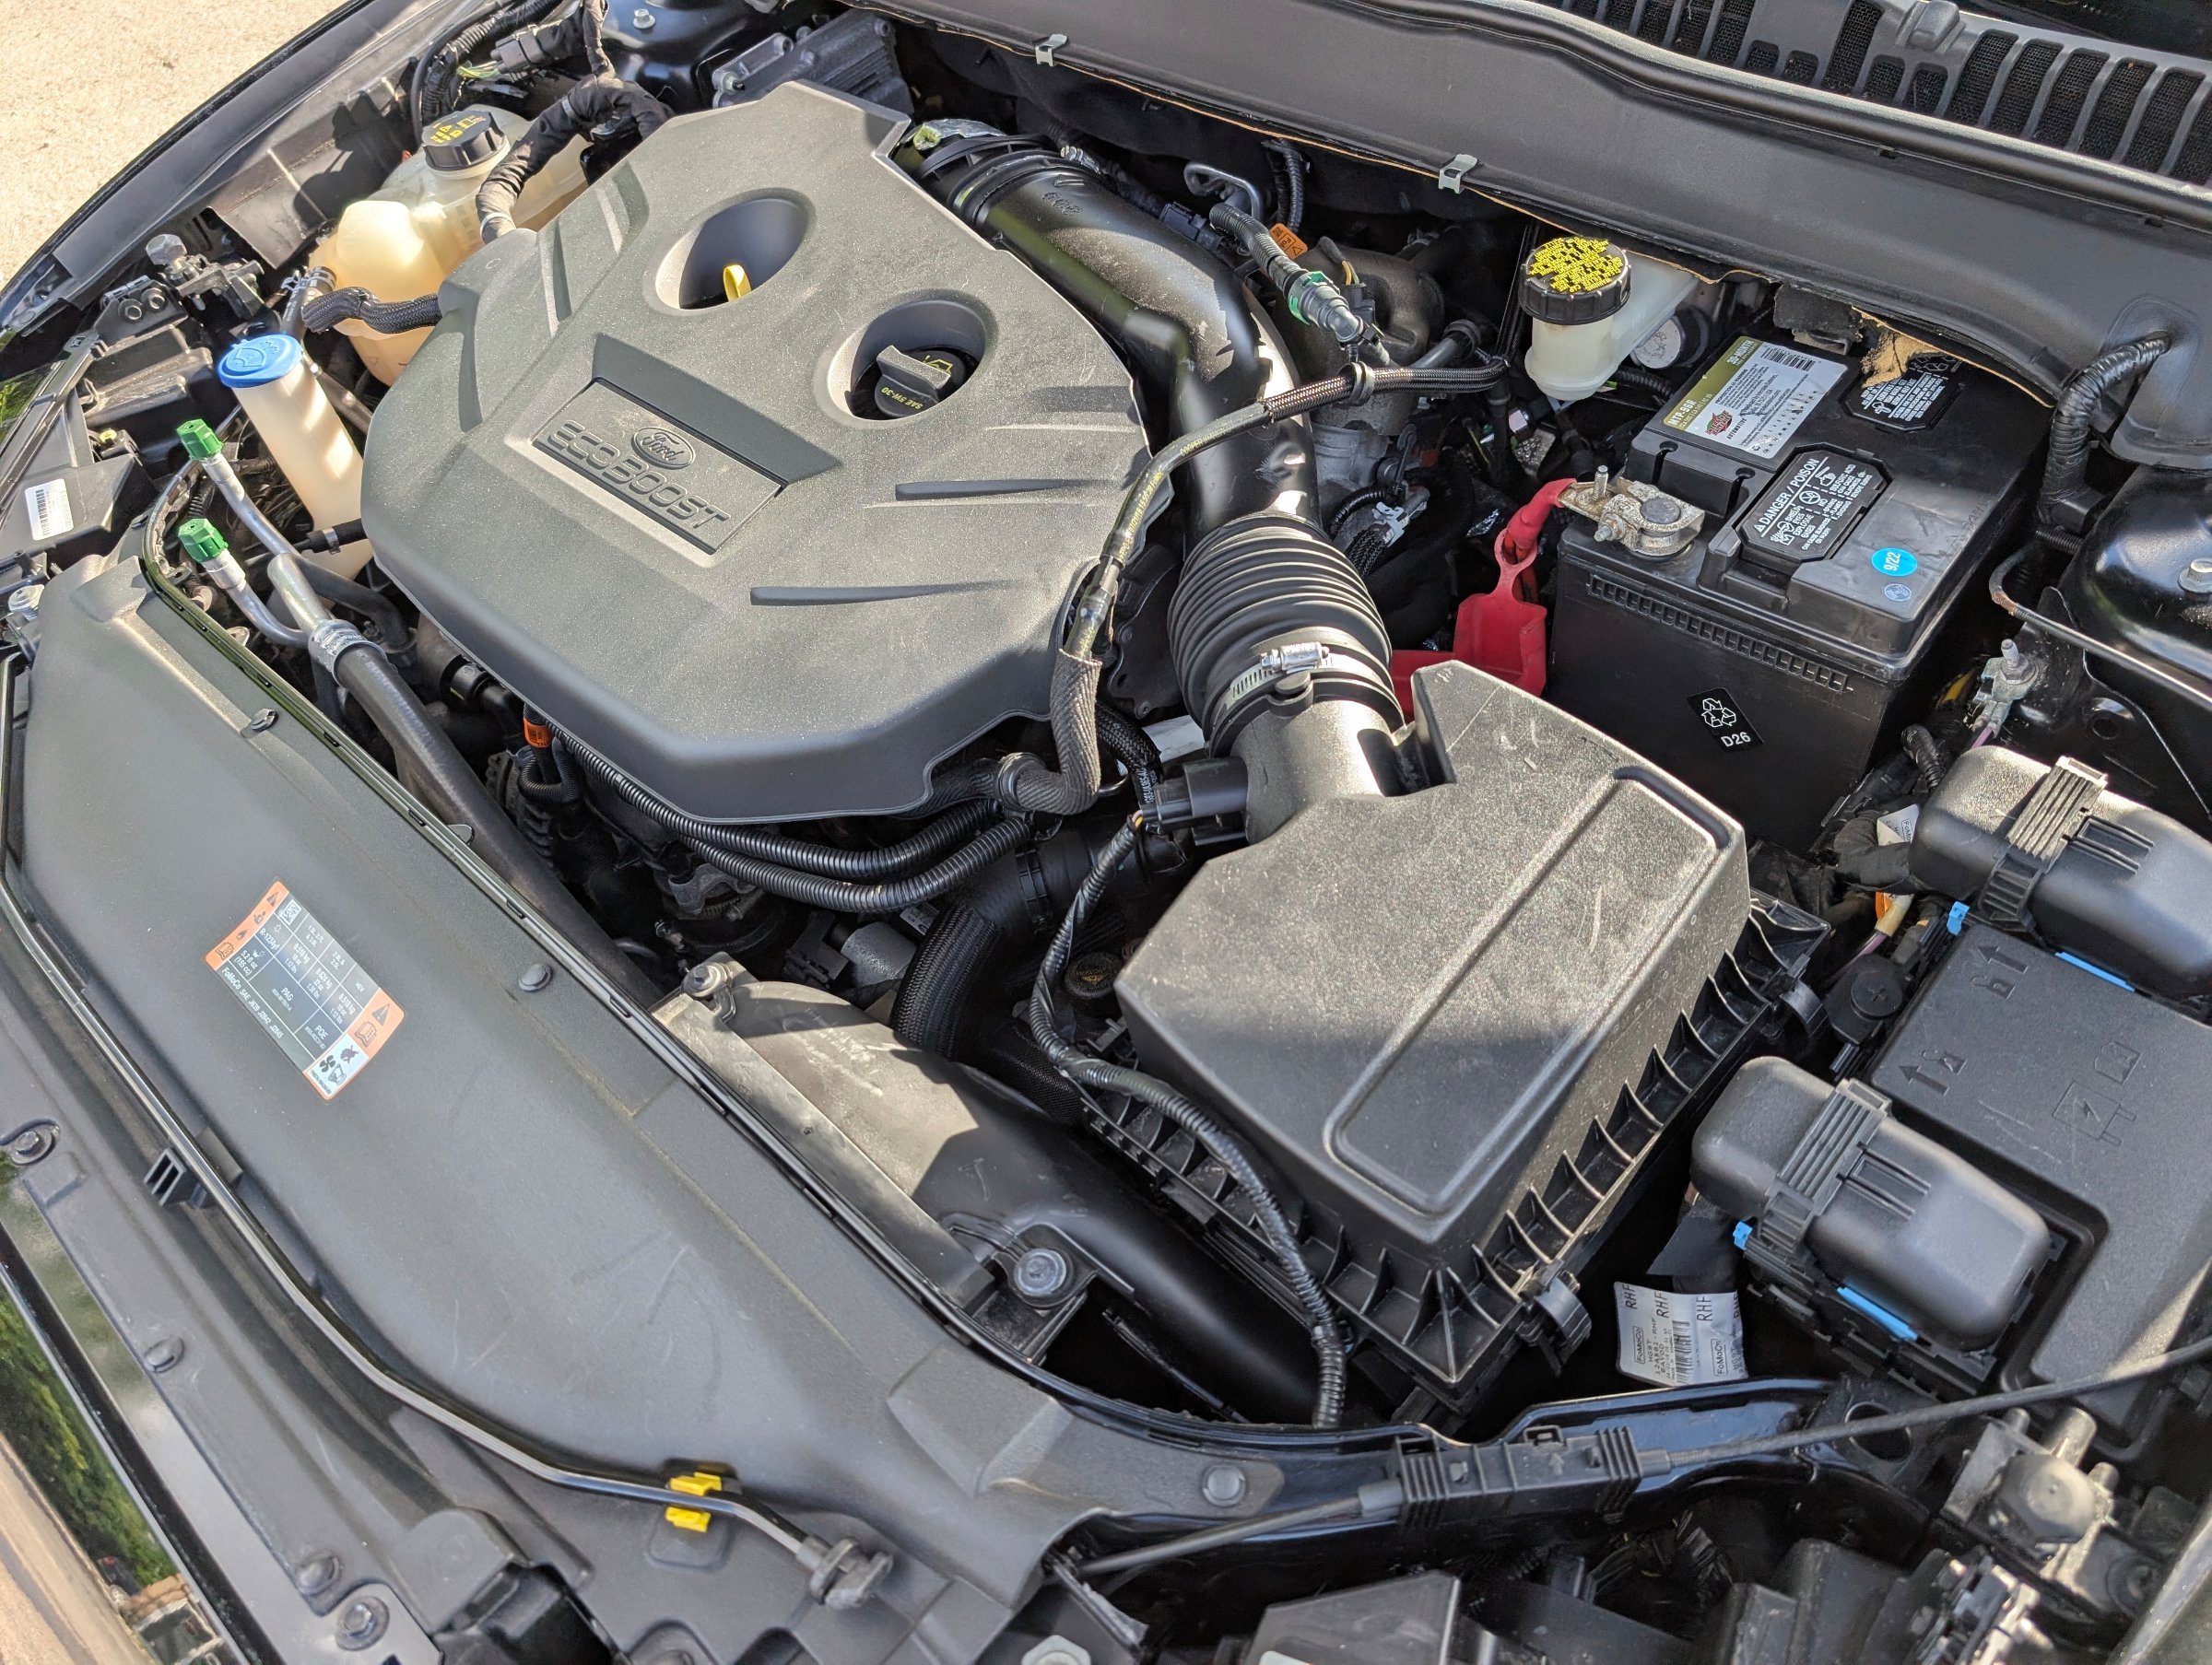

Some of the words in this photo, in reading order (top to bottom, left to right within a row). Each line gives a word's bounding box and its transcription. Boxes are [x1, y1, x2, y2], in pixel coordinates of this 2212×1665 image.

[881, 387, 907, 403] 5W-30
[905, 399, 923, 410] SAE
[1668, 400, 1698, 426] MTP-96R
[642, 431, 685, 463] Ford
[547, 419, 731, 528] ECOBOOST
[1759, 491, 1793, 525] DANGER
[1790, 458, 1820, 488] POISON
[1882, 550, 1903, 573] 9/22
[1720, 732, 1751, 746] D26
[259, 928, 280, 952] R-1234yf
[234, 955, 246, 968] (155
[241, 964, 253, 977] cc)
[241, 950, 250, 960] 5.2
[250, 961, 258, 970] oz
[221, 967, 242, 991] FoMoCo
[240, 989, 251, 1001] SAE
[281, 987, 294, 1002] PAG
[314, 1025, 328, 1040] POE
[1622, 1284, 1638, 1309] RHF
[1653, 1292, 1669, 1318] RHF
[1696, 1296, 1713, 1321] RHF
[1635, 1329, 1643, 1362] FoMoCo
